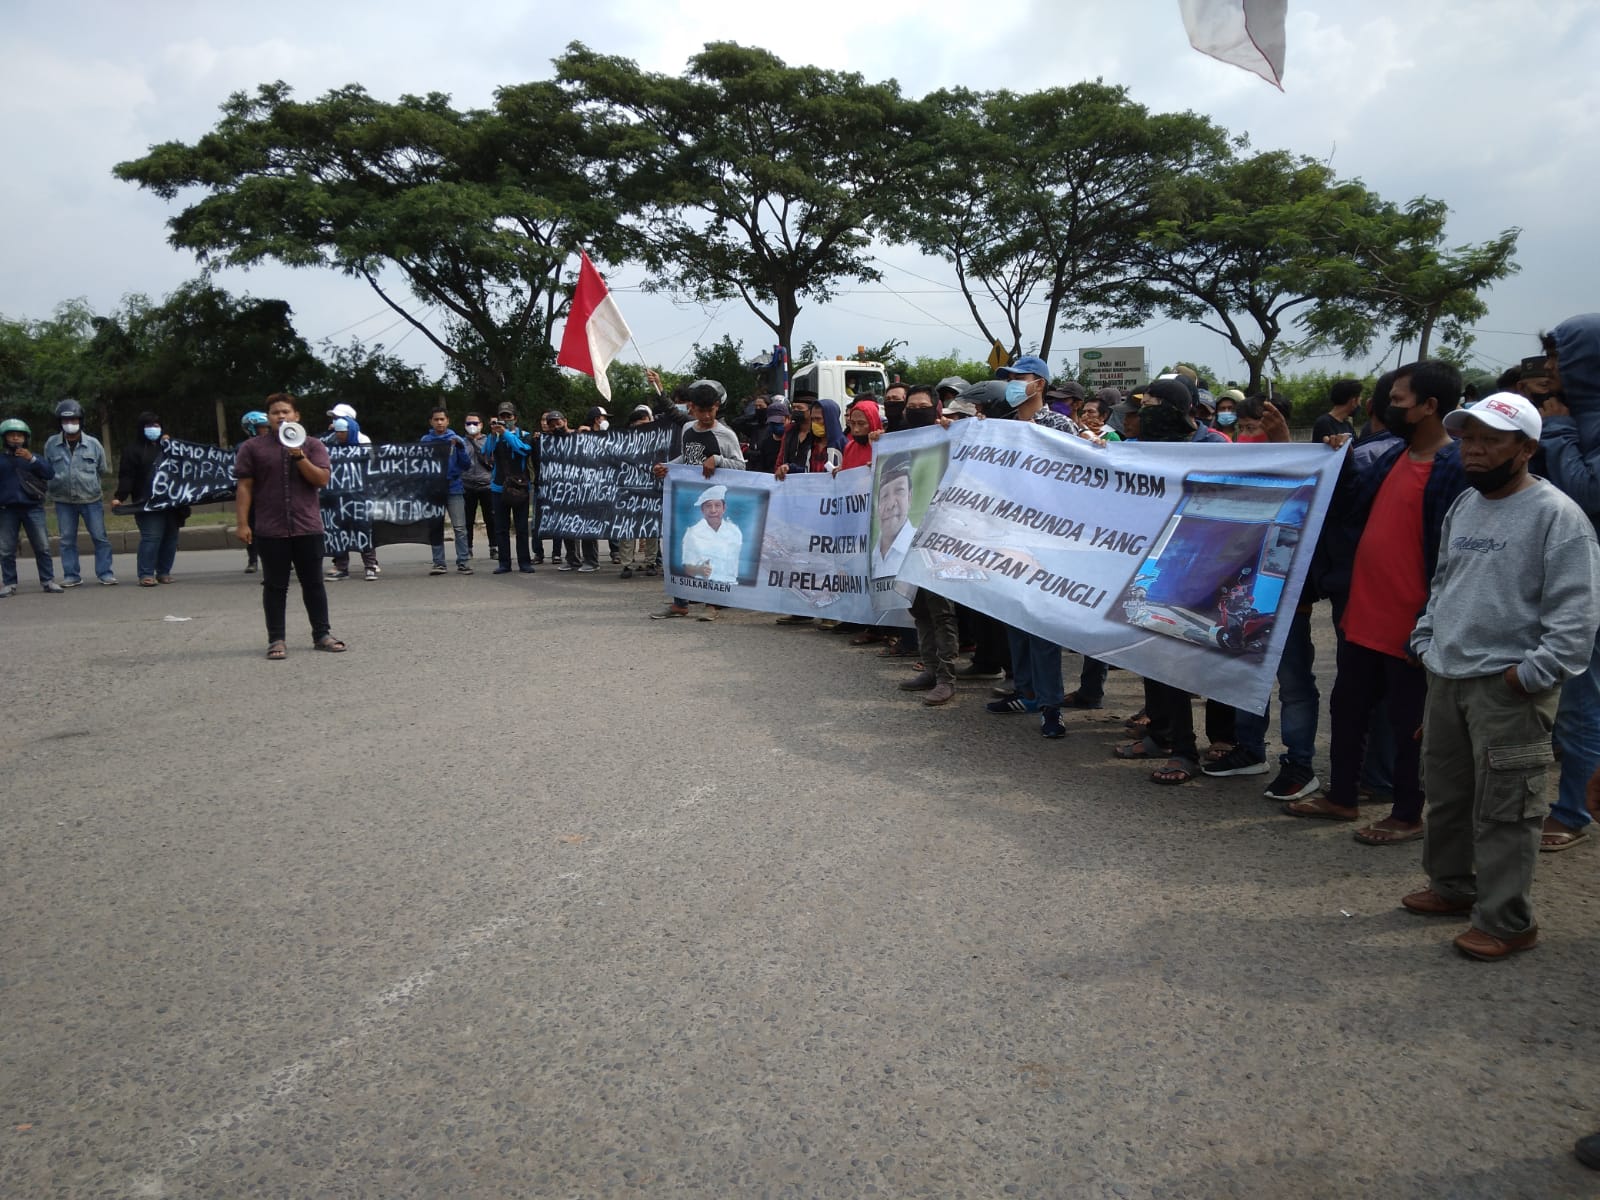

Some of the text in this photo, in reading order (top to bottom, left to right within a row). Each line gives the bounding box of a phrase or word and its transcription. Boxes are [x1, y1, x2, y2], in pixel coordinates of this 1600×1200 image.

[161, 439, 205, 458] DEMO
[326, 444, 434, 459] AKYAT JANGAN
[540, 433, 573, 456] KAMI
[325, 462, 363, 491] KAN
[1019, 454, 1109, 490] KOPERASI
[1115, 470, 1166, 498] TKBM
[610, 515, 637, 538] HAK
[639, 514, 663, 538] KA
[991, 499, 1085, 542] MARUNDA
[1089, 526, 1148, 556] YANG
[808, 534, 858, 554] PRAKTEK
[768, 570, 784, 588] DI
[789, 571, 862, 594] PELABUHAN
[921, 532, 1029, 580] BERMUATAN
[1025, 568, 1107, 609] PUNGLI
[679, 577, 731, 592] SULKARNAEN
